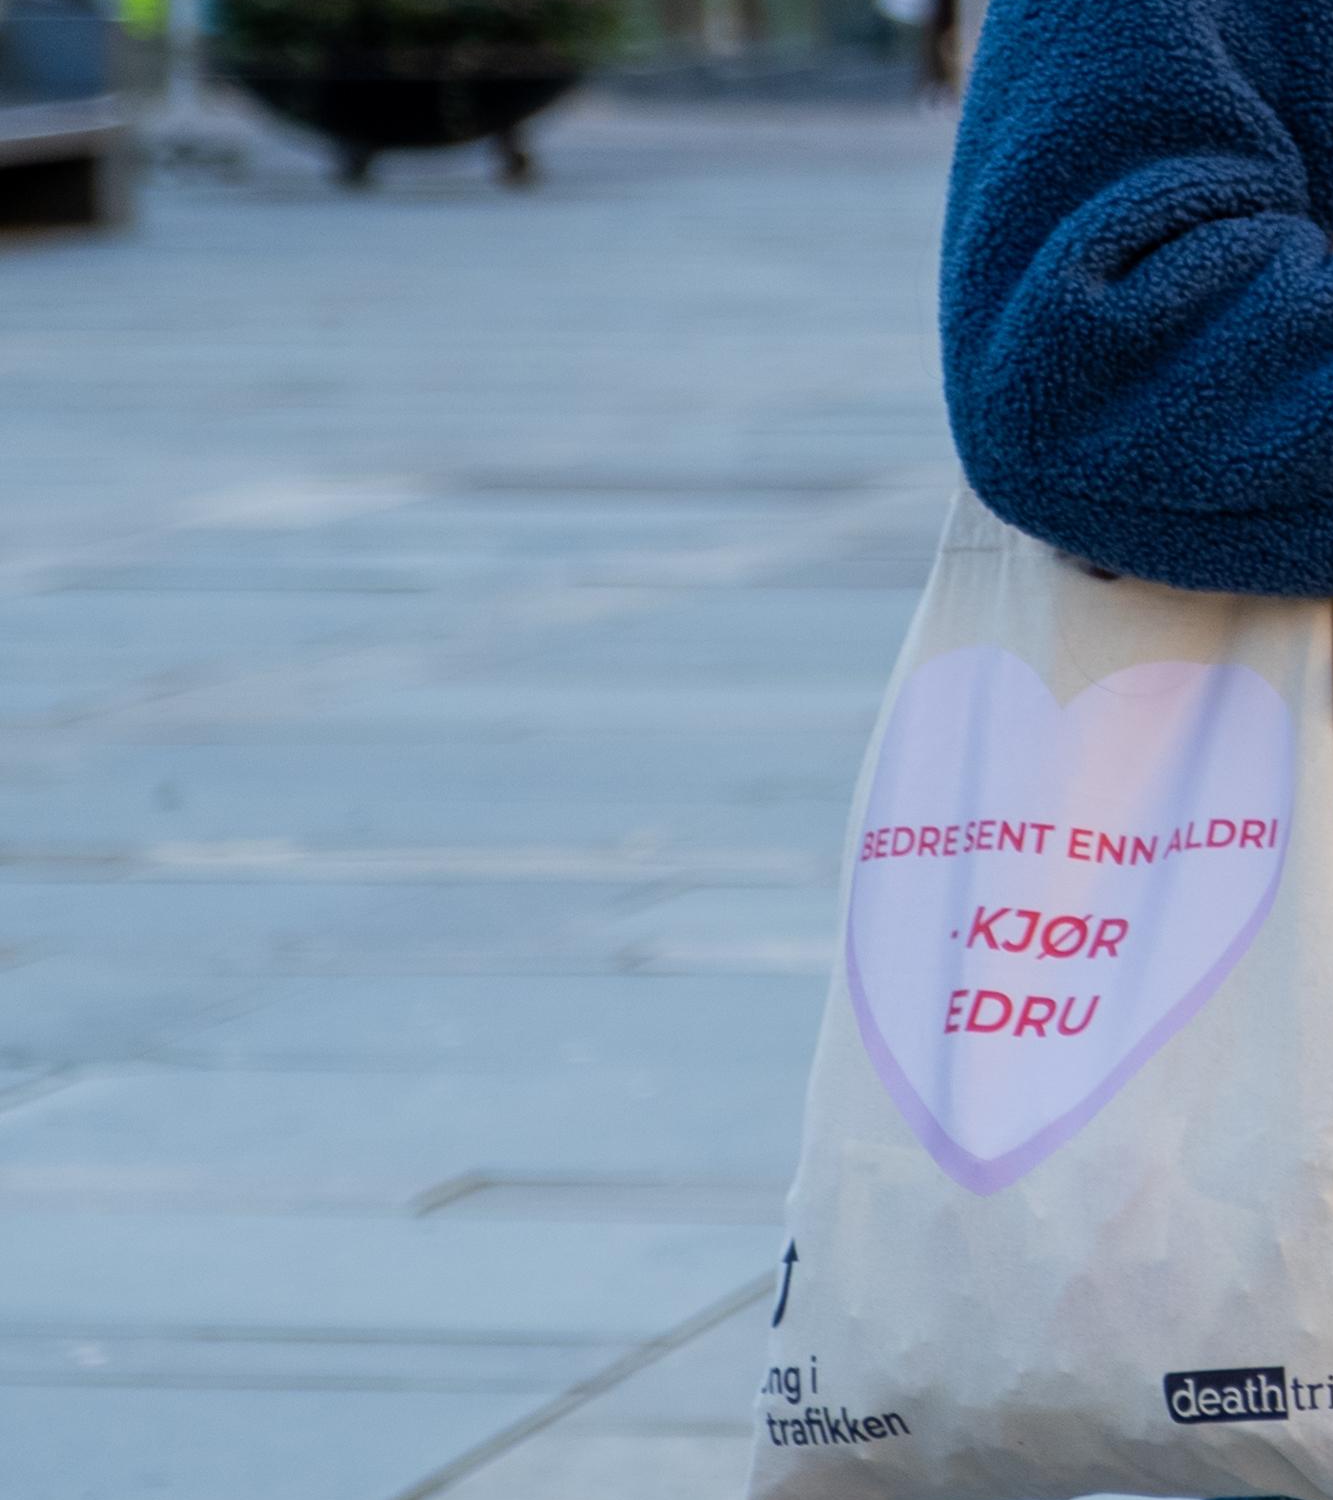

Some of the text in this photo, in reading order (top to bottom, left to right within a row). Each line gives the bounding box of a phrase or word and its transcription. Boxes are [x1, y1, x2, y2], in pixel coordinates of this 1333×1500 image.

[1067, 827, 1159, 865] ENN
[1162, 818, 1279, 860] ALDRI
[965, 906, 1130, 960] KJØR
[944, 989, 1102, 1038] EDRU
[761, 1354, 819, 1405] ng i
[766, 1406, 912, 1447] trafikken
